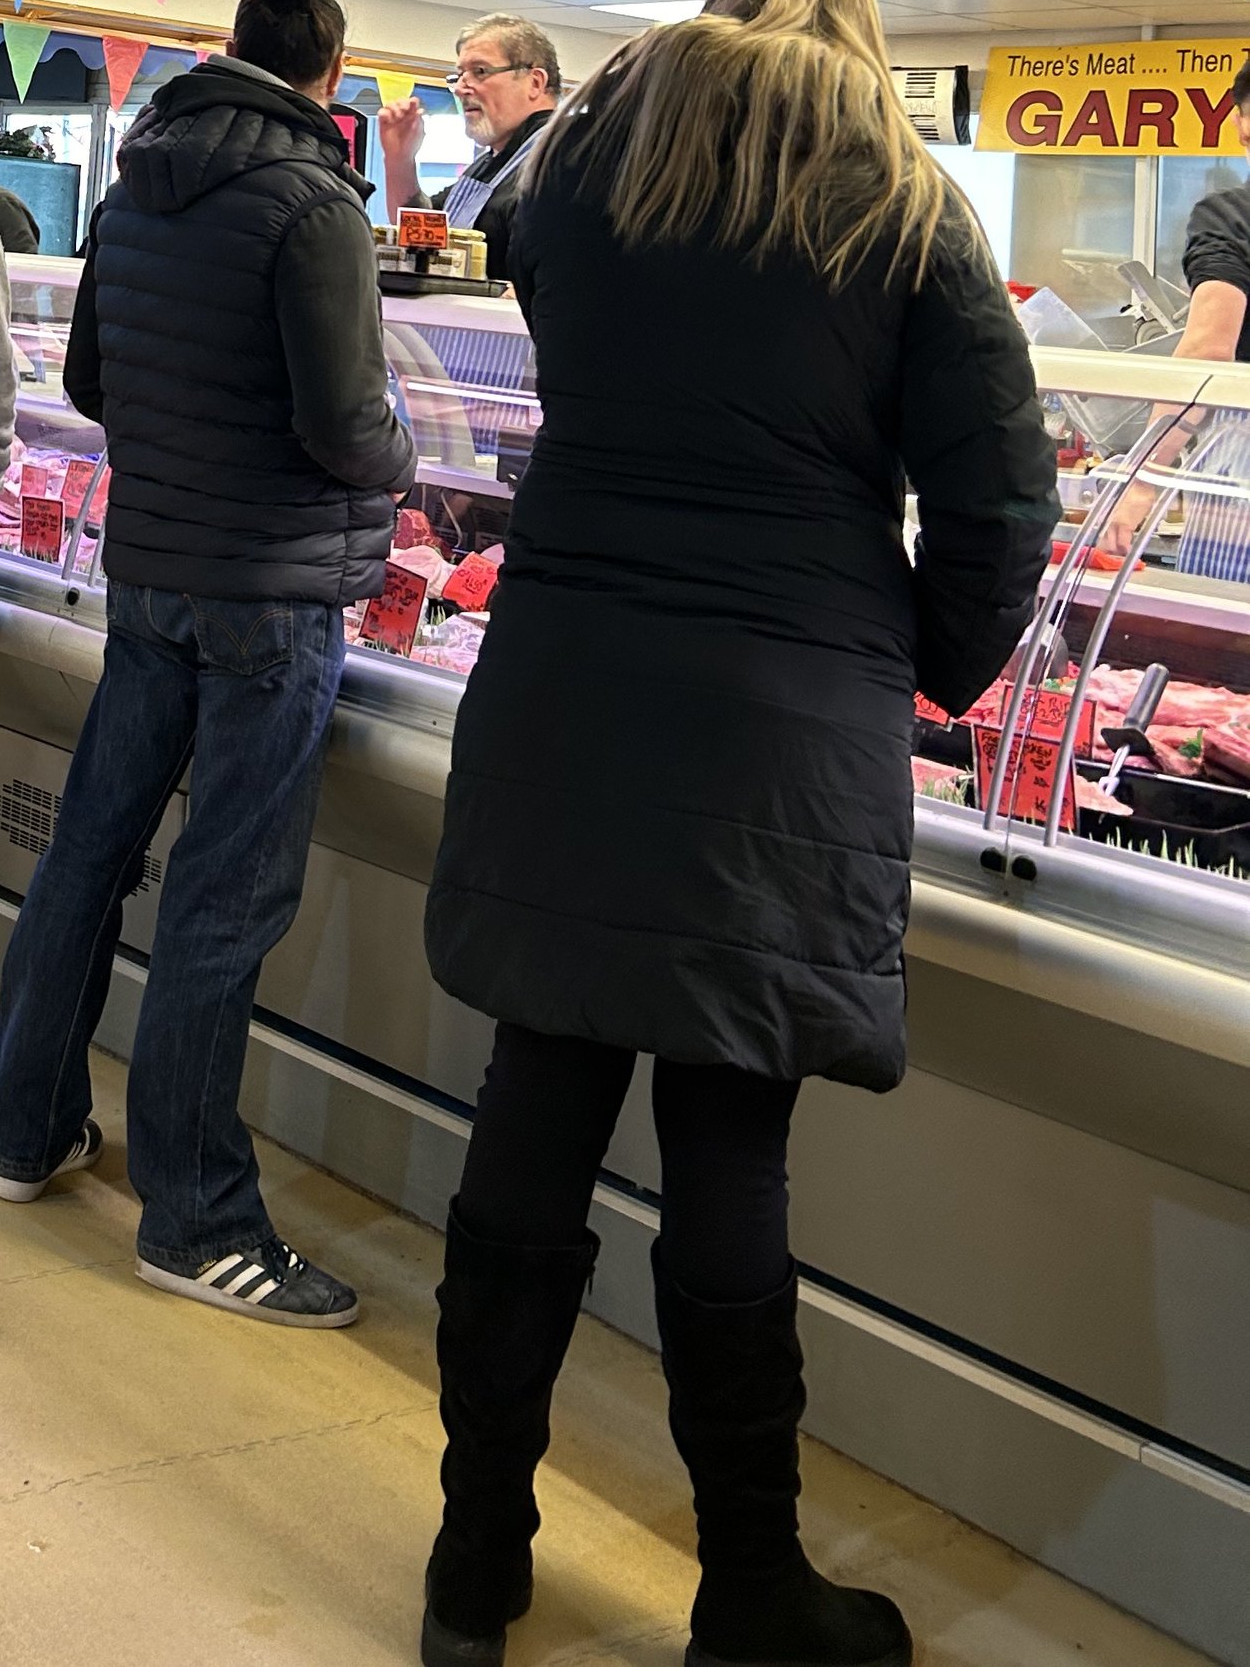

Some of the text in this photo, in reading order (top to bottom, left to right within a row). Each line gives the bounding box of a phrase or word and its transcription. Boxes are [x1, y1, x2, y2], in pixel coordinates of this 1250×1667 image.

[1007, 54, 1079, 77] There's
[1086, 53, 1135, 75] Meat
[1176, 49, 1232, 72] Then
